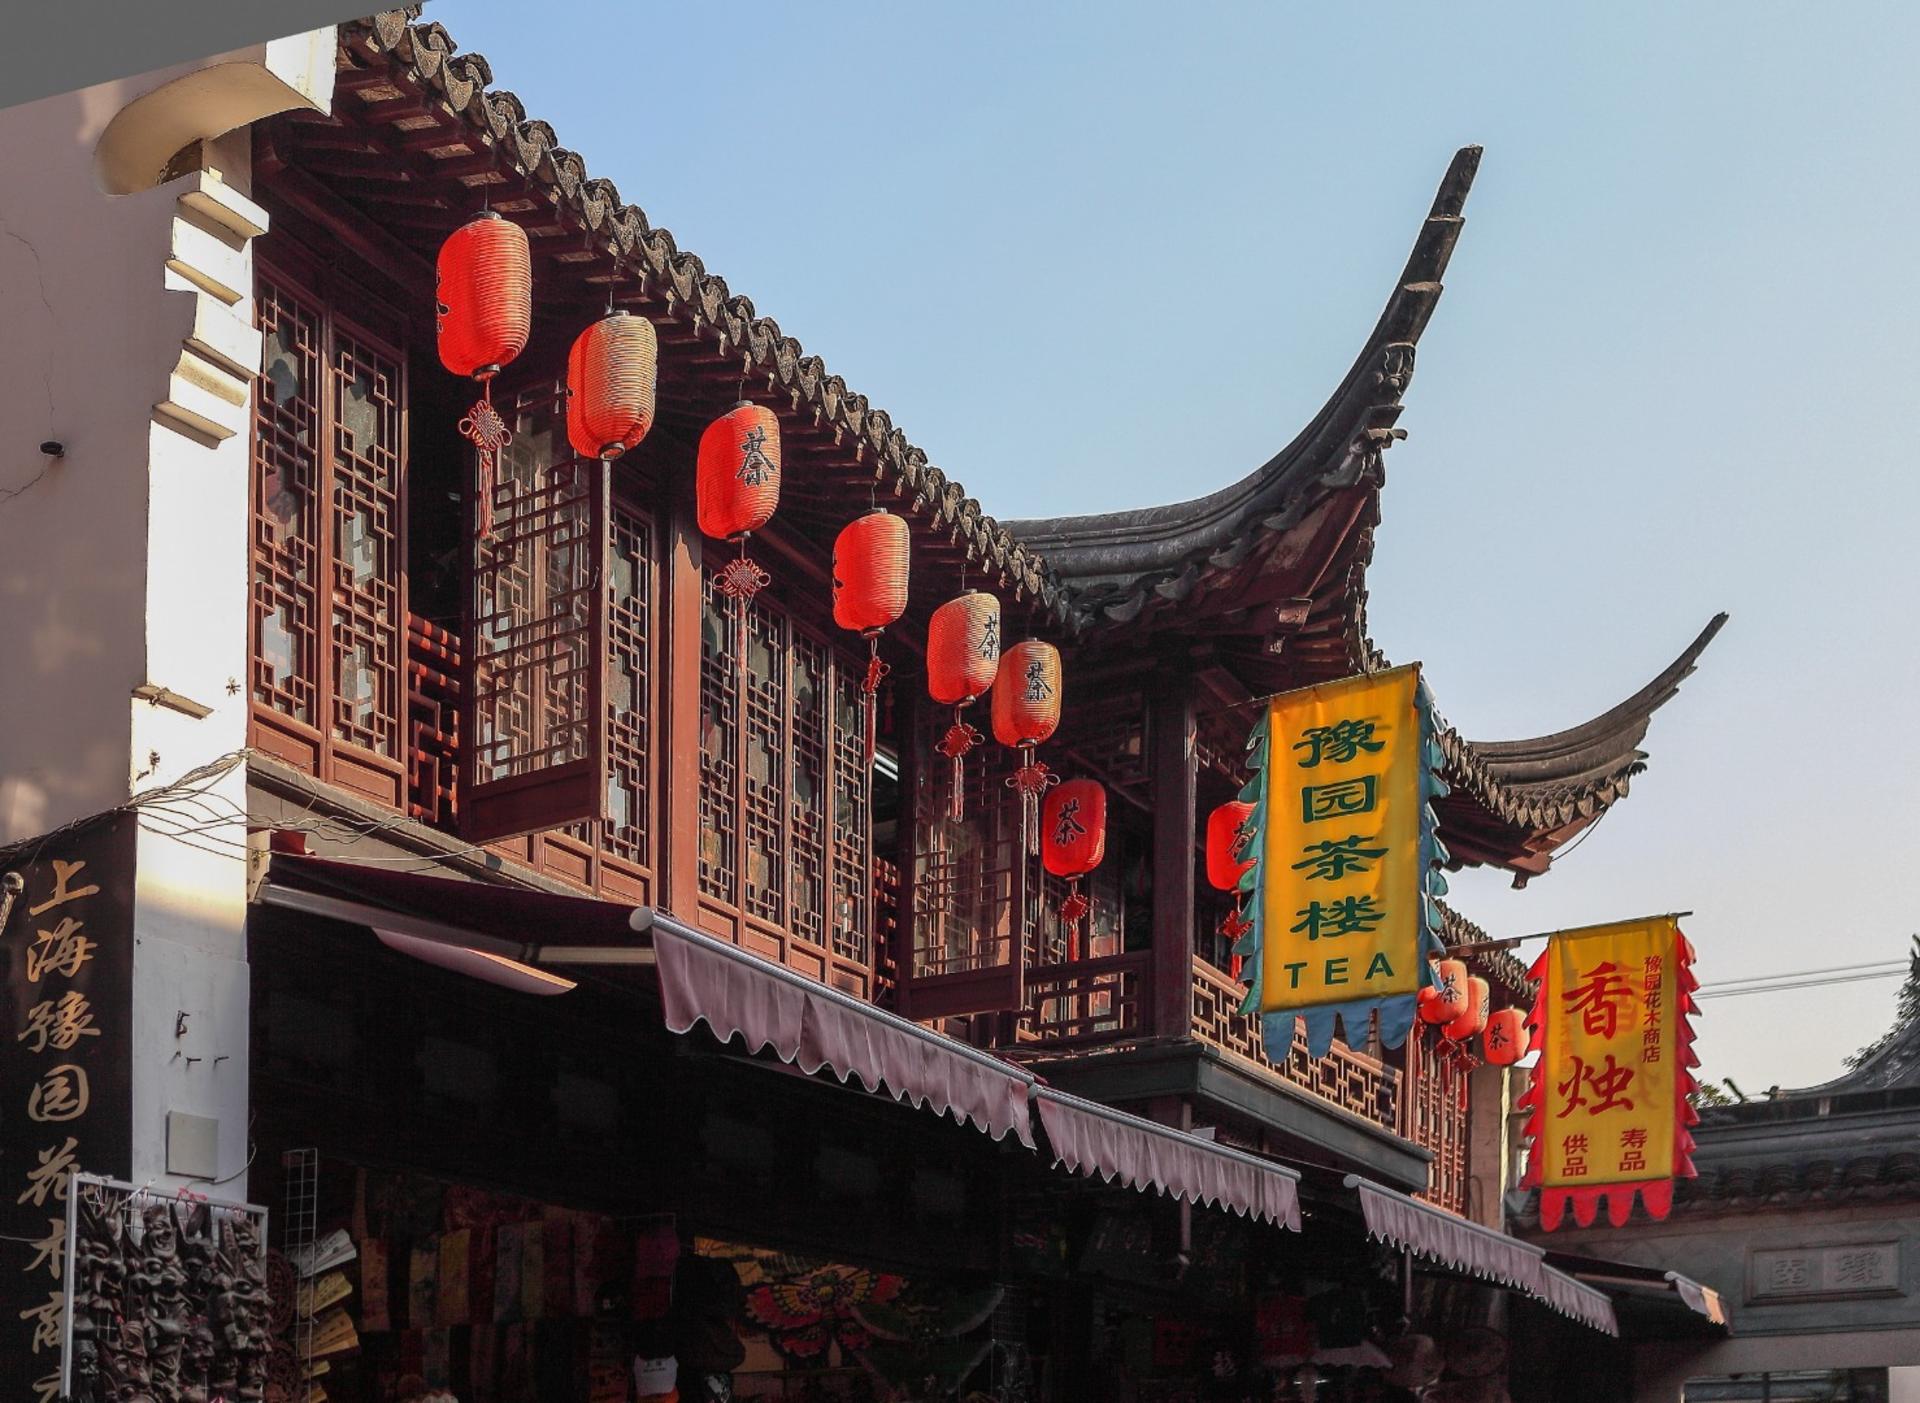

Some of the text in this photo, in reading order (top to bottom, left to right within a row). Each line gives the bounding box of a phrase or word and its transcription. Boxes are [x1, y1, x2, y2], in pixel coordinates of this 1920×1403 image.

[737, 425, 775, 487] 茶
[977, 612, 1000, 660] 茶
[1023, 661, 1053, 703] 茶
[1054, 798, 1086, 847] 茶
[1290, 719, 1390, 941] 豫园茶楼
[1284, 952, 1395, 990] TEA
[1441, 974, 1462, 1004] 茶
[1641, 954, 1663, 1064] 豫园花木商店
[1490, 1023, 1509, 1050] 茶
[1556, 961, 1635, 1119] 香烛
[1561, 1135, 1589, 1177] 供品
[1619, 1128, 1647, 1171] 寿品
